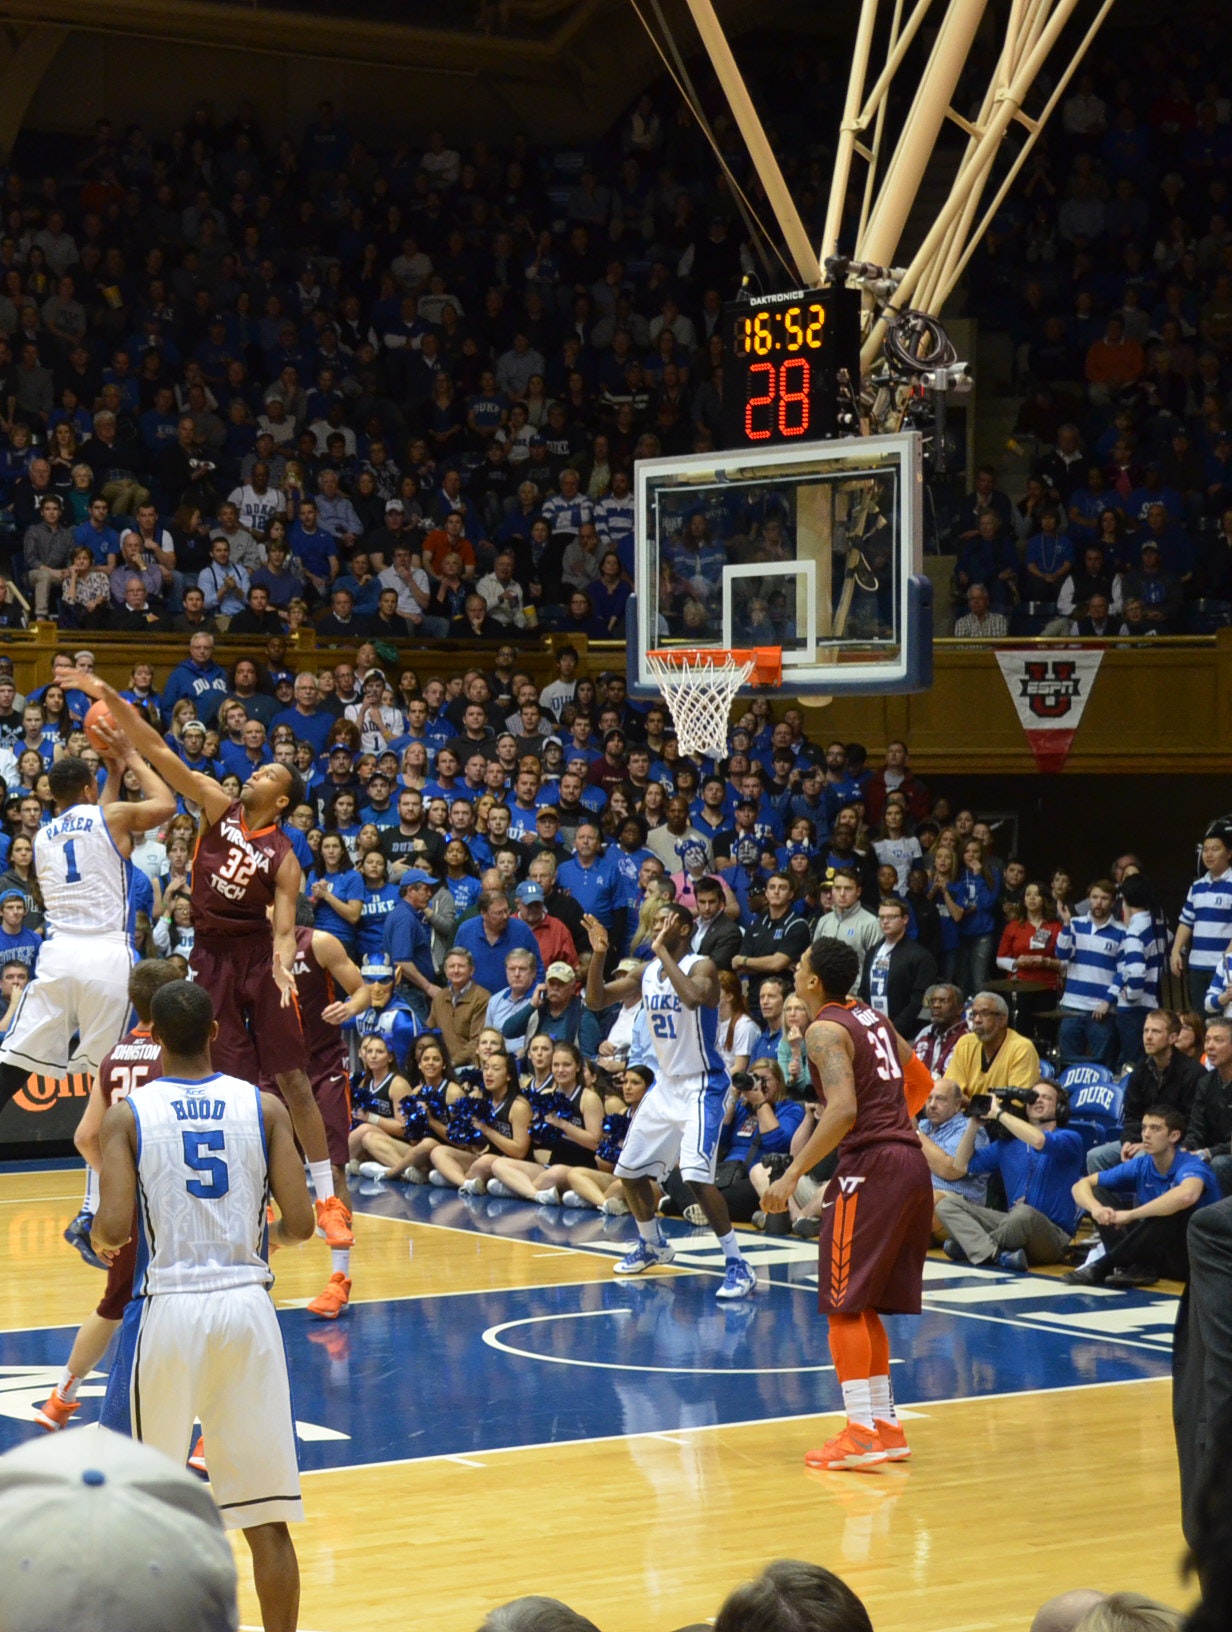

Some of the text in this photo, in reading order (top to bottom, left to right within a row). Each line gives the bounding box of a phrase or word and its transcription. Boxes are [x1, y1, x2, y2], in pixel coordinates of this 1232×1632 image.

[750, 290, 804, 306] DAKTRONICS
[744, 304, 825, 355] 16:52
[744, 357, 811, 440] 28
[1026, 682, 1075, 695] ESPN
[46, 817, 94, 841] PARKER
[392, 841, 414, 853] DUK
[63, 839, 82, 884] 1
[218, 847, 257, 885] 32
[208, 873, 247, 901] TECH
[359, 900, 395, 916] DUKE
[651, 1014, 677, 1039] 21
[111, 1044, 161, 1061] JOHNSTON
[867, 1026, 903, 1082] 31
[1065, 1066, 1101, 1089] DUKE
[171, 1099, 226, 1121] HOOD
[1075, 1085, 1115, 1111] DUKE
[181, 1129, 230, 1200] 5
[838, 1176, 866, 1194] VT
